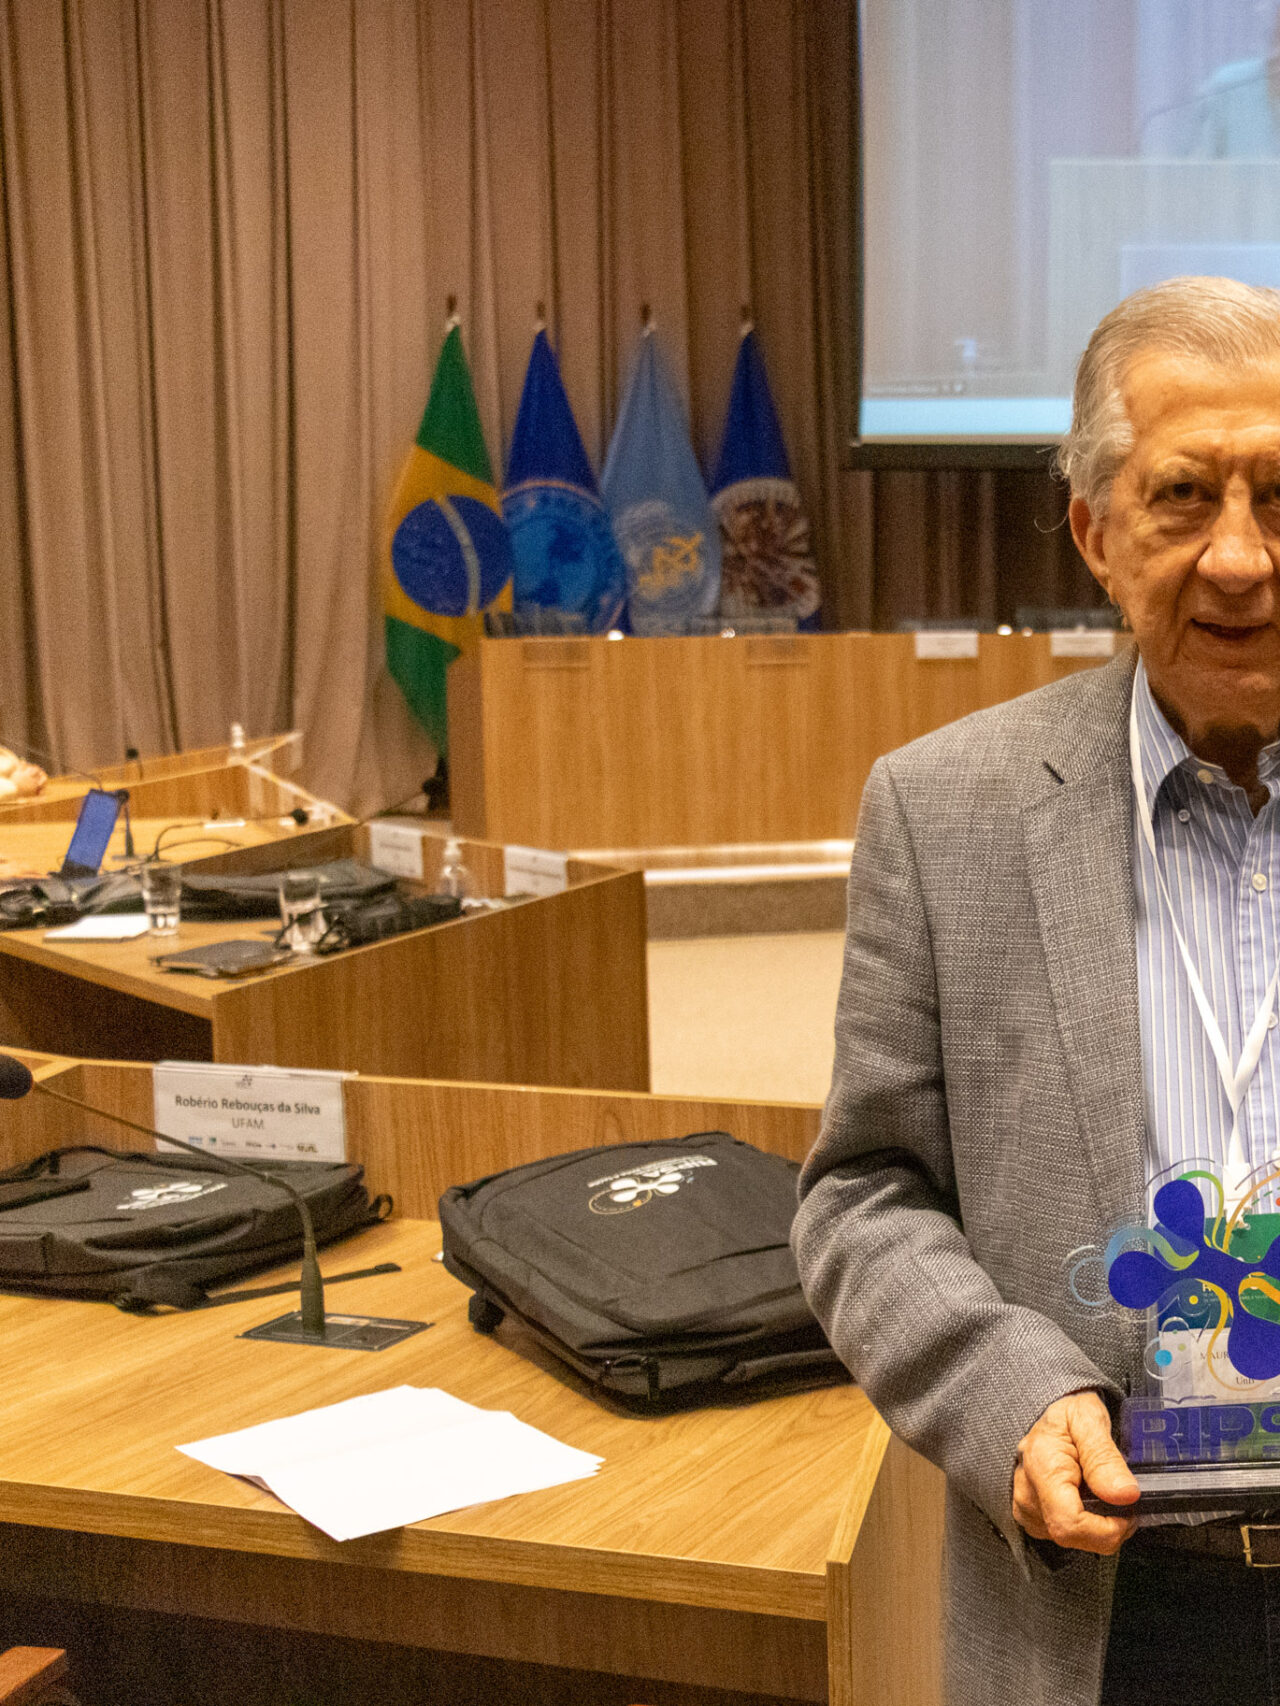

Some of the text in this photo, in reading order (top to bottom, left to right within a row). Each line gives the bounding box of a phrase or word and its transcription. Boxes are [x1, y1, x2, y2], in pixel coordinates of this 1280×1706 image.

[174, 1095, 321, 1115] Robério Rebouças da Silva
[231, 1117, 265, 1130] UFAM
